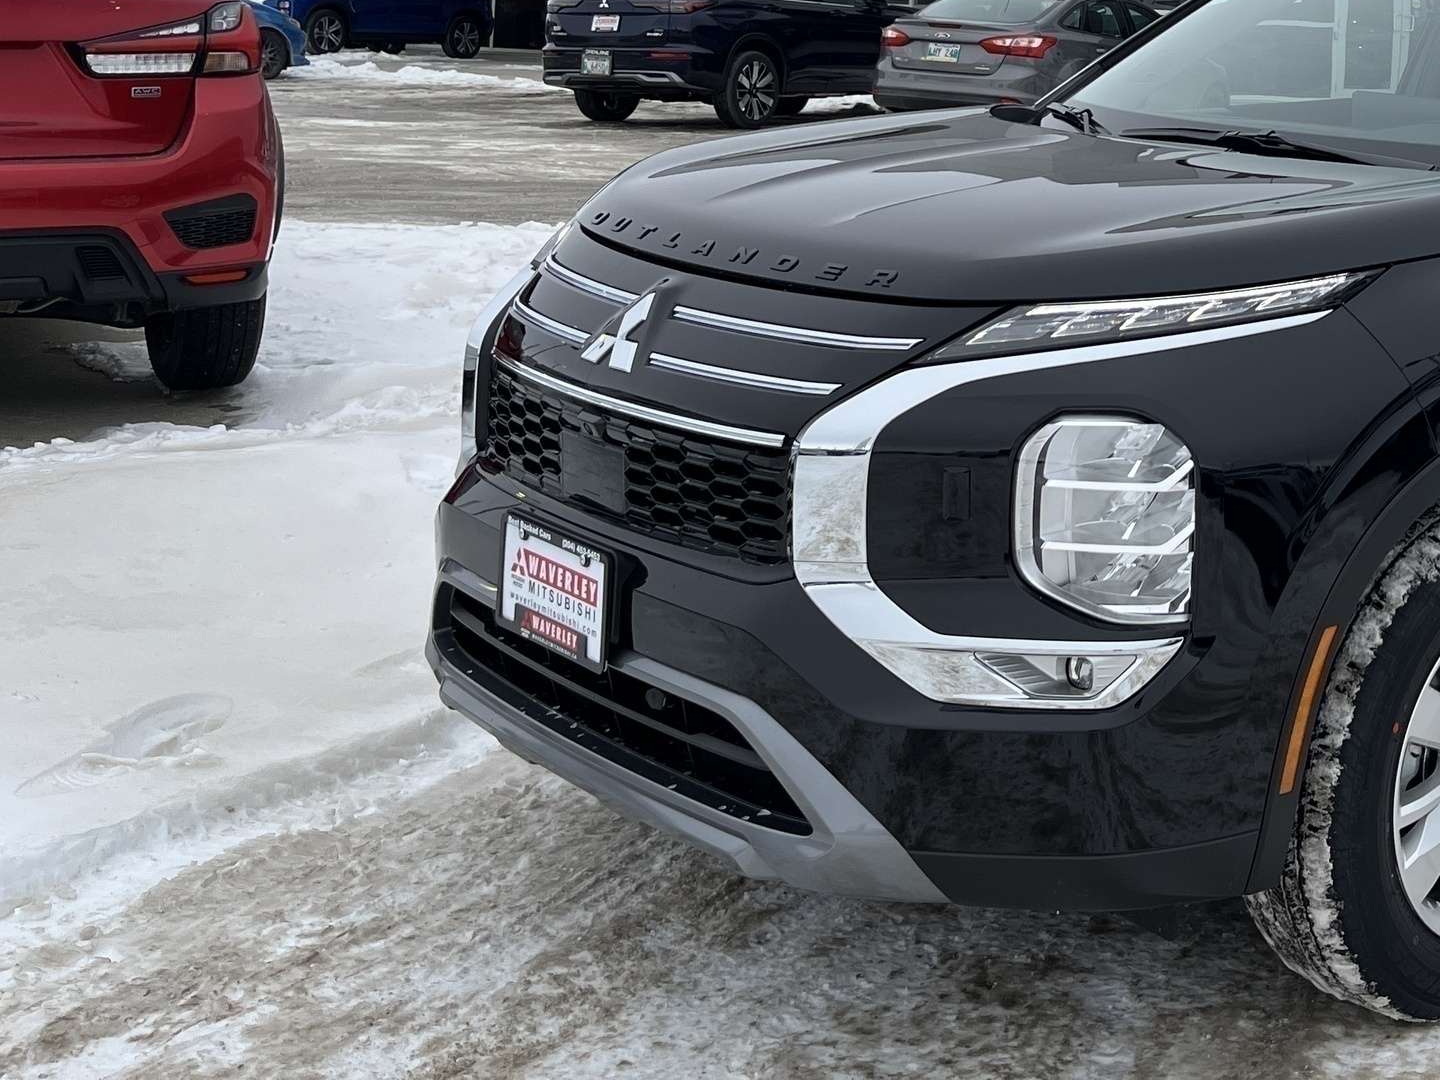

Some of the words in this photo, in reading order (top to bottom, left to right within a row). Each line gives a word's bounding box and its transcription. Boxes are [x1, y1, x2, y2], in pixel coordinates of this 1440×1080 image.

[591, 212, 899, 288] OUTLANDER
[528, 554, 598, 603] WAVERLEY
[528, 580, 597, 623] MITSUBISHI
[532, 614, 577, 649] WAVERLEY
